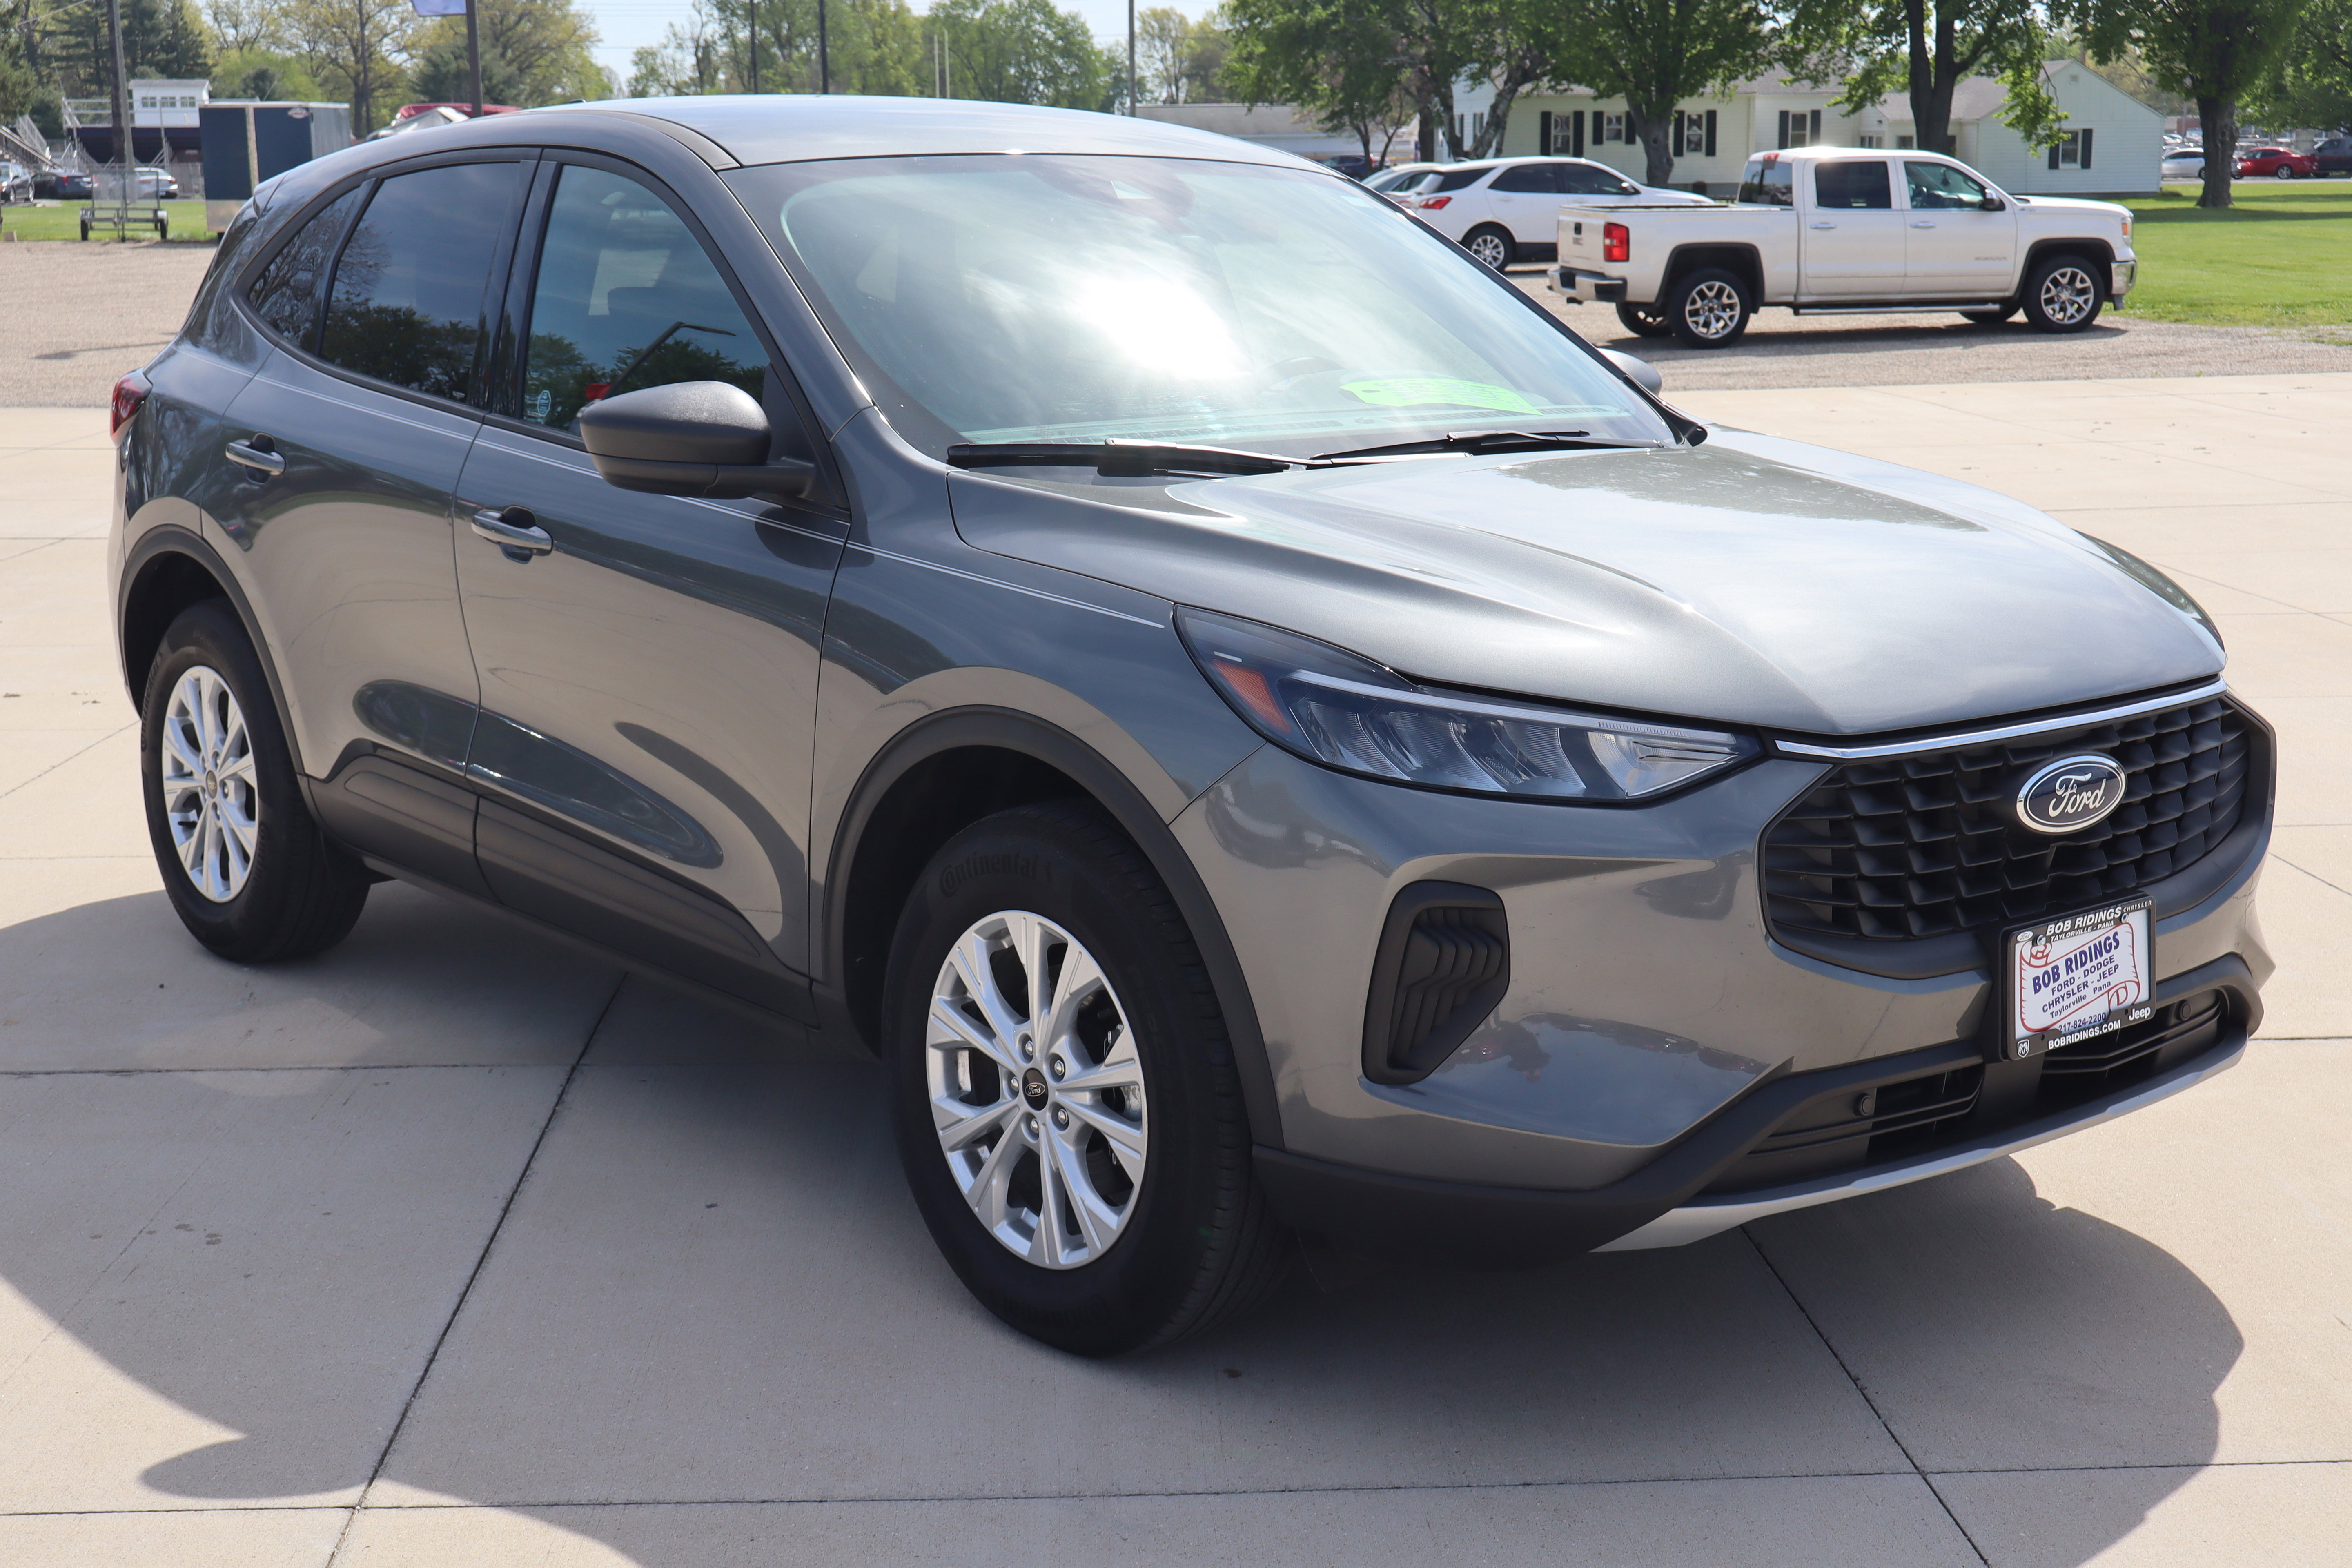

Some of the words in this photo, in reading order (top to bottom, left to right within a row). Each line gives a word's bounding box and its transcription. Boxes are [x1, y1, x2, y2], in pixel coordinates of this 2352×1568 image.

[2049, 773, 2106, 817] Ford
[940, 851, 1039, 897] Continental
[2046, 920, 2071, 936] BOB
[2075, 906, 2122, 929] RIDINGS
[2123, 900, 2152, 912] CHRYSLER
[2050, 926, 2091, 942] TAYLORVILLE
[2097, 920, 2114, 930] PANA
[2032, 964, 2060, 995] BOB
[2065, 931, 2119, 976] RIDINGS
[2051, 978, 2075, 996] FORD
[2084, 955, 2115, 977] DODGE
[2042, 980, 2089, 1013] CHRYSLER
[2097, 964, 2119, 983] JEEP
[2050, 994, 2086, 1019] Taylorville
[2093, 981, 2111, 995] Pana
[2058, 1012, 2106, 1033] 217-824-2200
[2129, 1007, 2150, 1021] Jeep
[2048, 1020, 2120, 1050] BOBRIDINGS.COM
[1028, 1085, 1041, 1094] Ford
